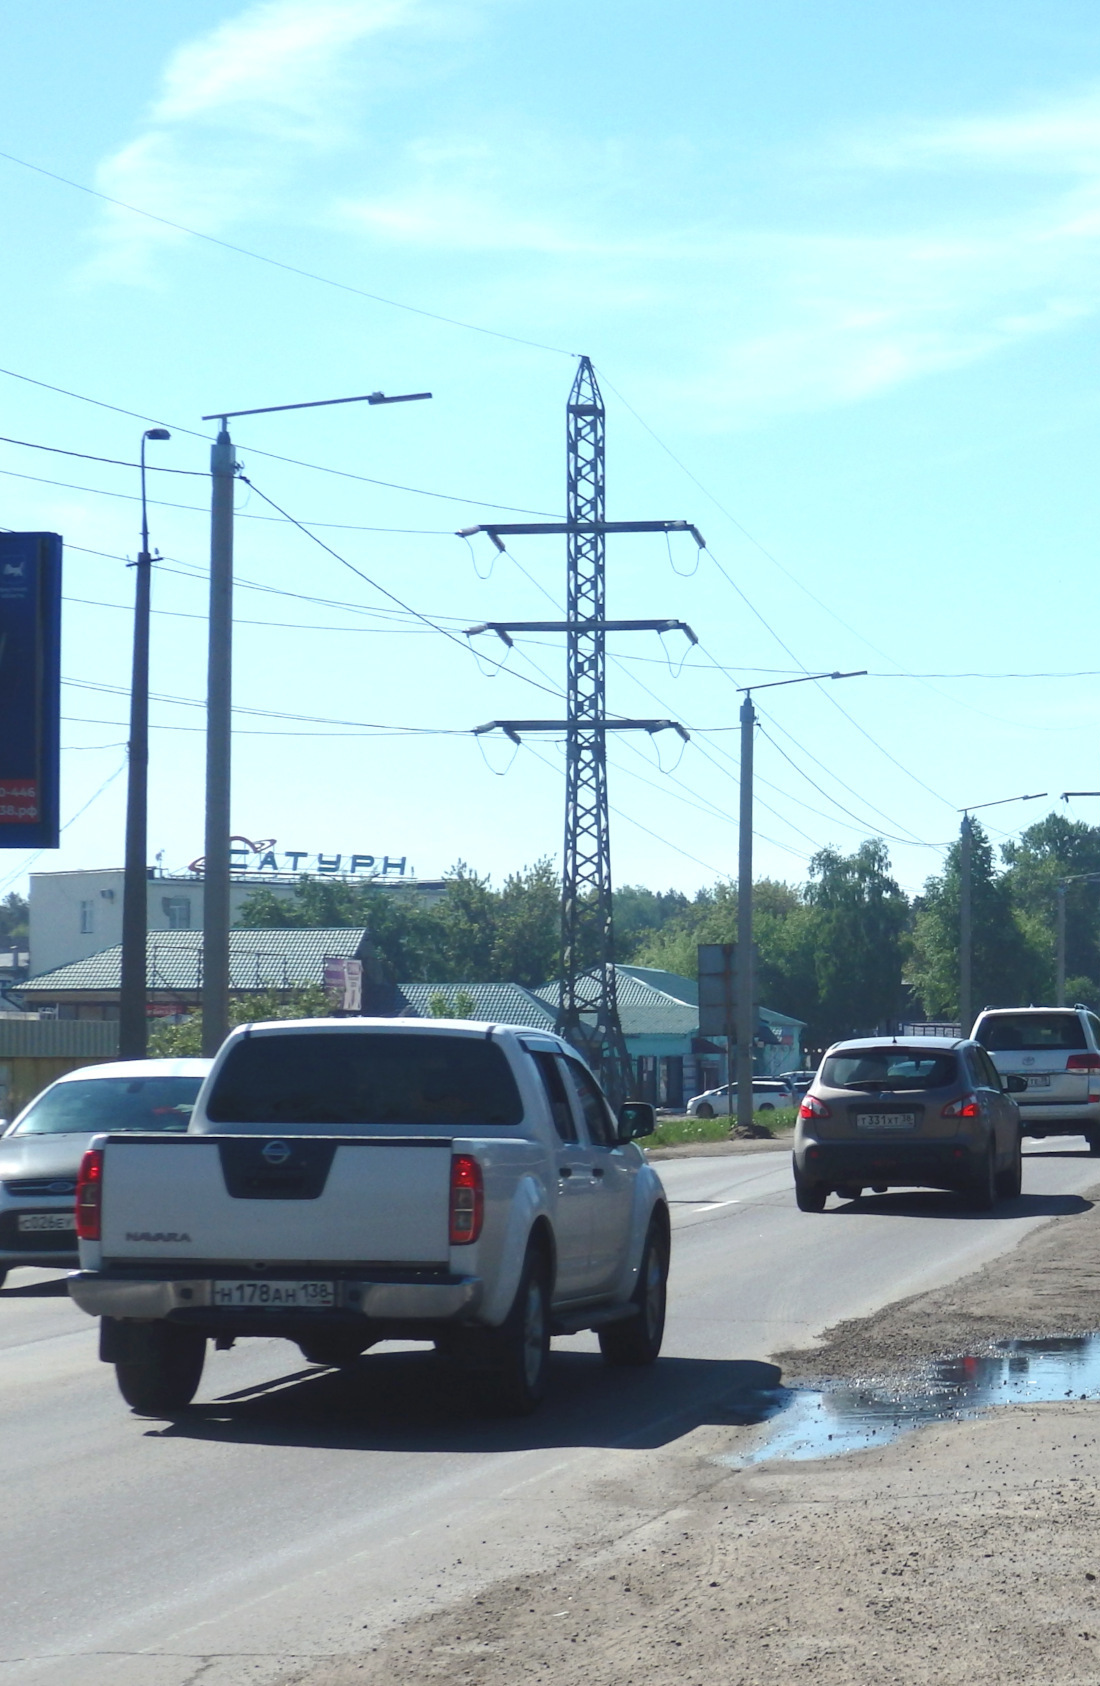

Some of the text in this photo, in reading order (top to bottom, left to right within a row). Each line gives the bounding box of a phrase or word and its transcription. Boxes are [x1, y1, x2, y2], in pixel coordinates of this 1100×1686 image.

[229, 849, 407, 875] САТУРН
[125, 1231, 192, 1243] NAVARA
[220, 1283, 328, 1303] Н178АН 138
